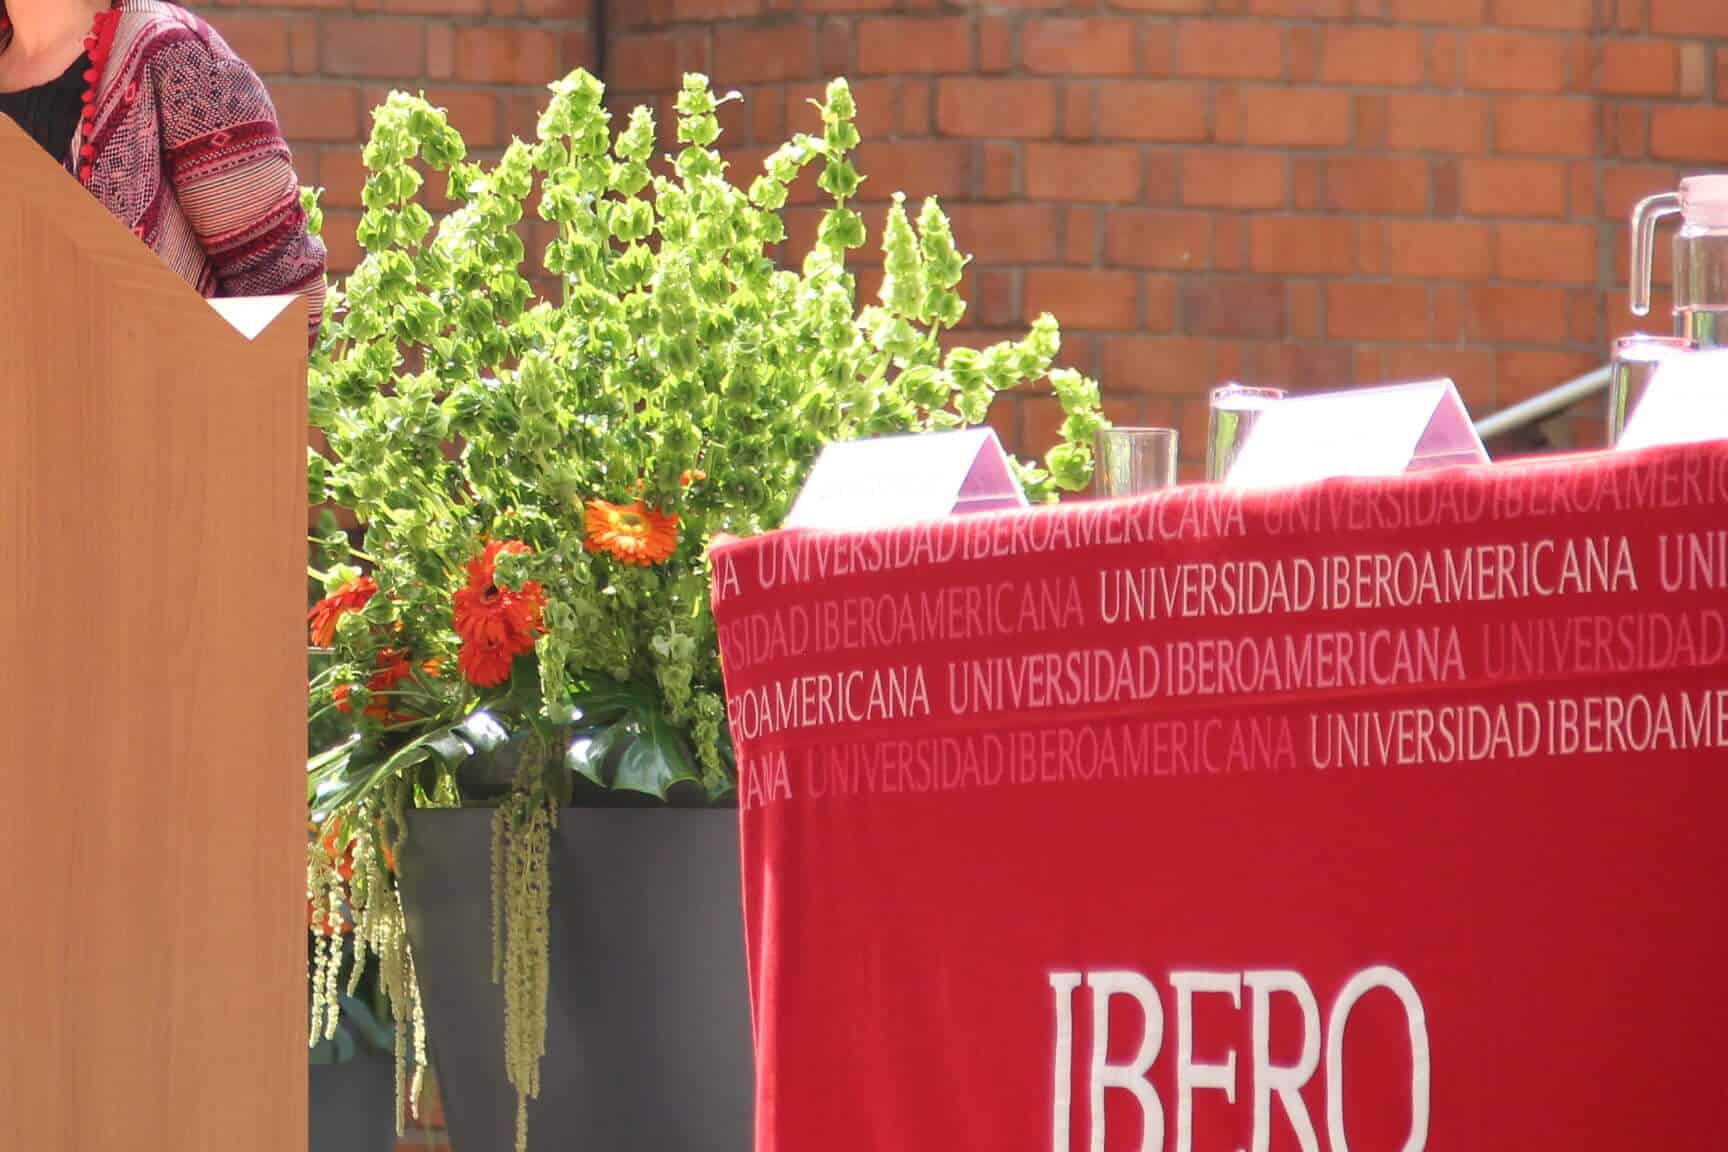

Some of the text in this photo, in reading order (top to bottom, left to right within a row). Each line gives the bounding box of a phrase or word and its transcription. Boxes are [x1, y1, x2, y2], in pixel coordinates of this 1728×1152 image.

[757, 520, 960, 589] UNIVERSIDAD
[962, 487, 1247, 561] IBEROAMERICANA
[814, 576, 1085, 651] IBEROAMERICANA
[1099, 559, 1315, 625] UNIVERSIDAD
[1321, 535, 1638, 610] IBEROAMERICANA
[948, 645, 1160, 716] UNIVERSIDAD
[1166, 625, 1466, 696] IBEROAMERICANA
[1483, 610, 1724, 678] UNIVERSIDAD
[807, 733, 1003, 798] UNIVERSIDAD
[1008, 716, 1297, 785] IBEROAMERICANA
[1311, 703, 1541, 768] UNIVERSIDAD
[1049, 965, 1431, 1152] IBERO
